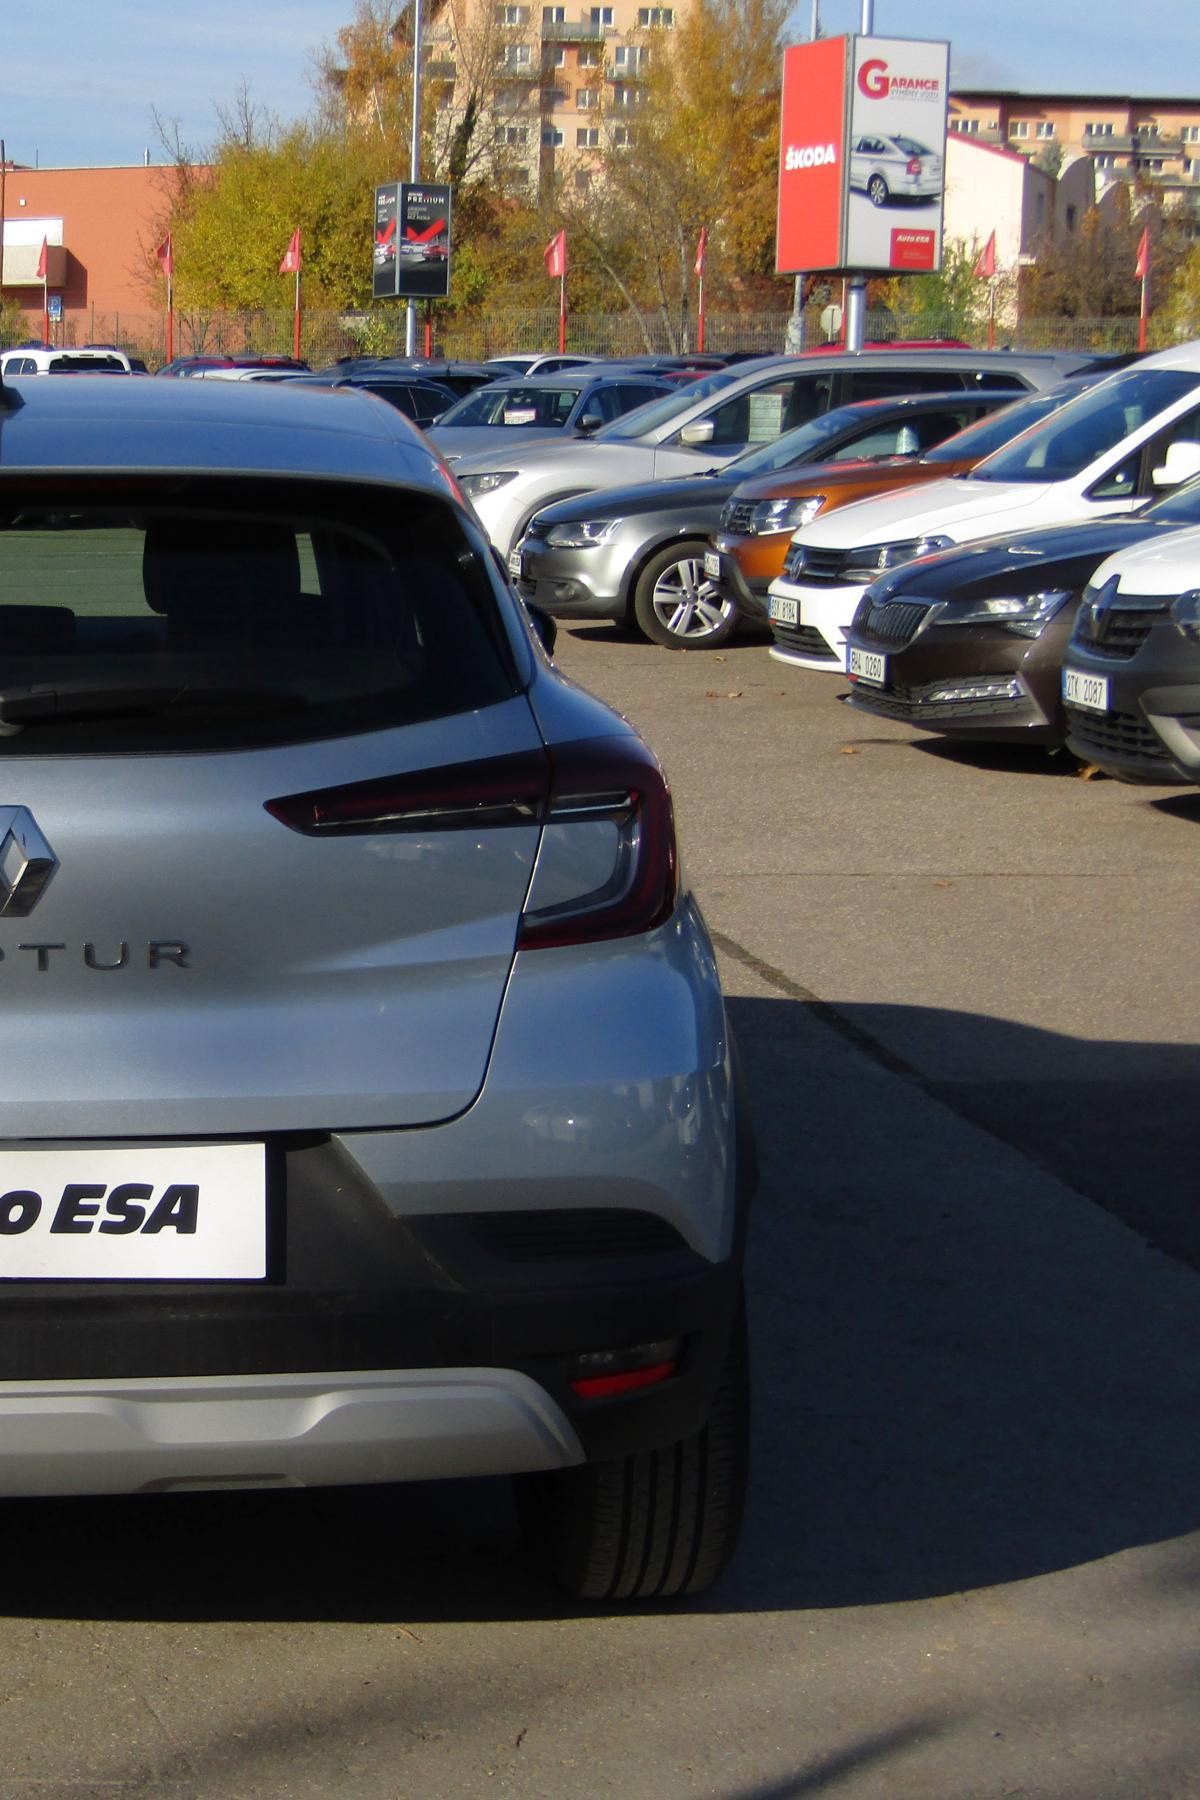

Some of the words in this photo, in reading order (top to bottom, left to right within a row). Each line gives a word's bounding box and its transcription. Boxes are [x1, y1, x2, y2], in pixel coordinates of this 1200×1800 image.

[858, 59, 939, 100] GARANCE
[785, 144, 836, 171] ŠKODA
[407, 195, 445, 205] PREMIUM
[865, 655, 882, 678] 0260
[1067, 674, 1079, 699] 2TK
[1084, 679, 1103, 705] 2087
[49, 1182, 201, 1235] ESA
